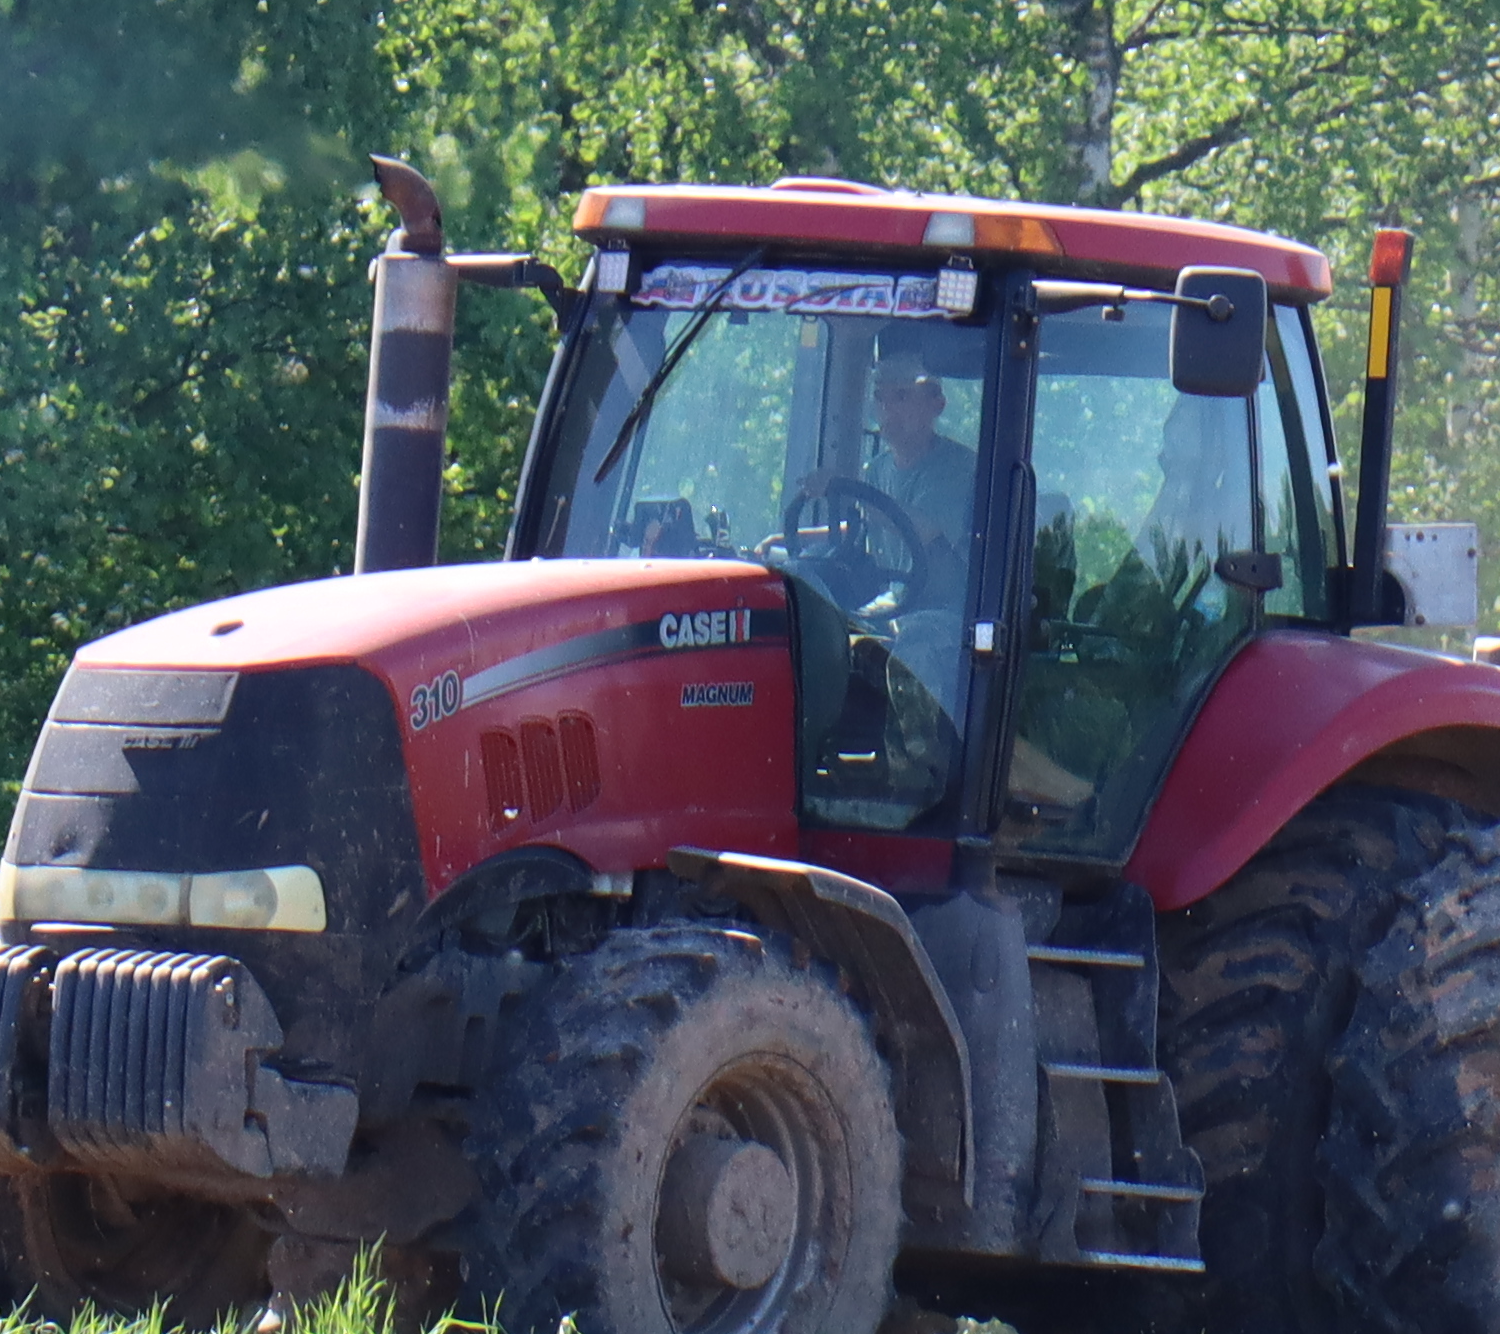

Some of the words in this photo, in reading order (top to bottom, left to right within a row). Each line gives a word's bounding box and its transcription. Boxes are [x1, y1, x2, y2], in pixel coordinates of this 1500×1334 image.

[660, 611, 727, 648] CASE
[410, 670, 460, 731] 310
[681, 681, 754, 707] MAGNUM
